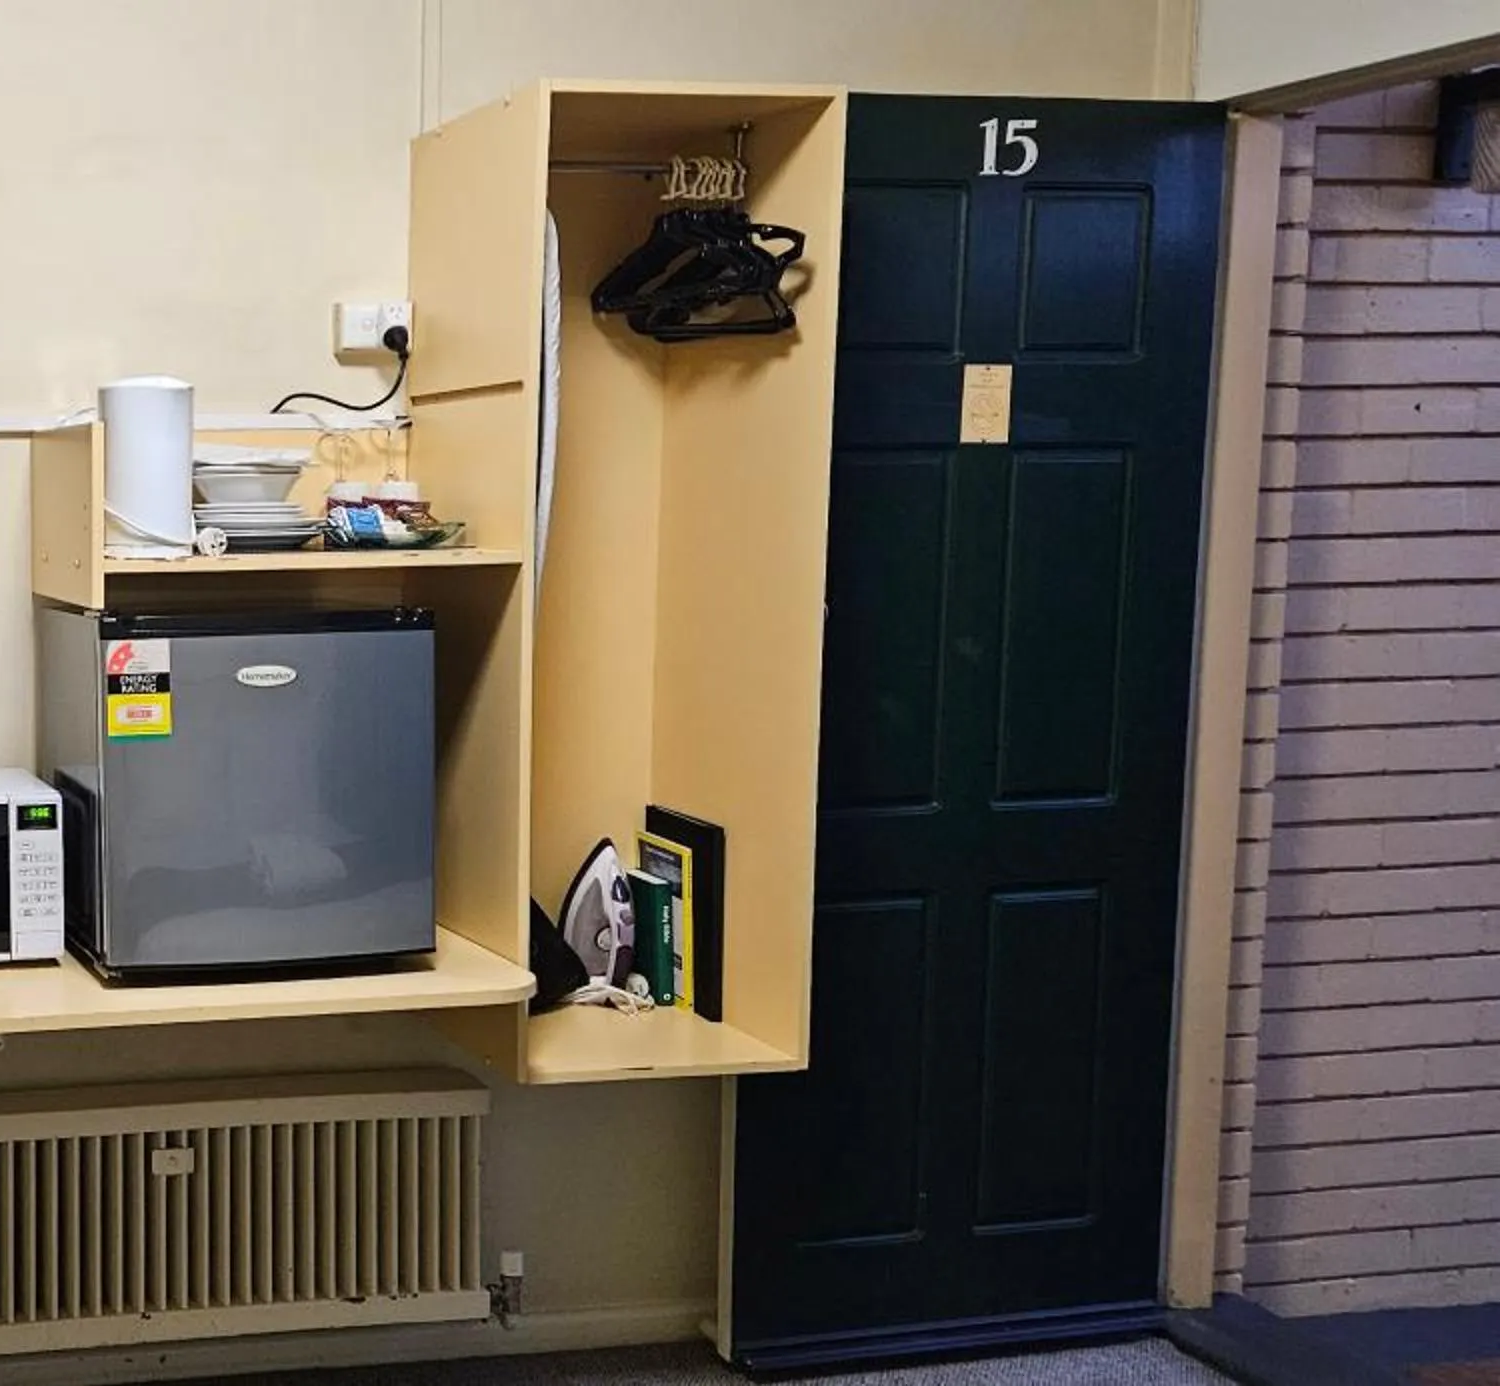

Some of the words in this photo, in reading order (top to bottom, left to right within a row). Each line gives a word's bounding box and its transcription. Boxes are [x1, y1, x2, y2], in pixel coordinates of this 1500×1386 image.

[980, 118, 1039, 176] 15
[120, 674, 157, 684] ENERGY
[121, 684, 157, 693] RATING
